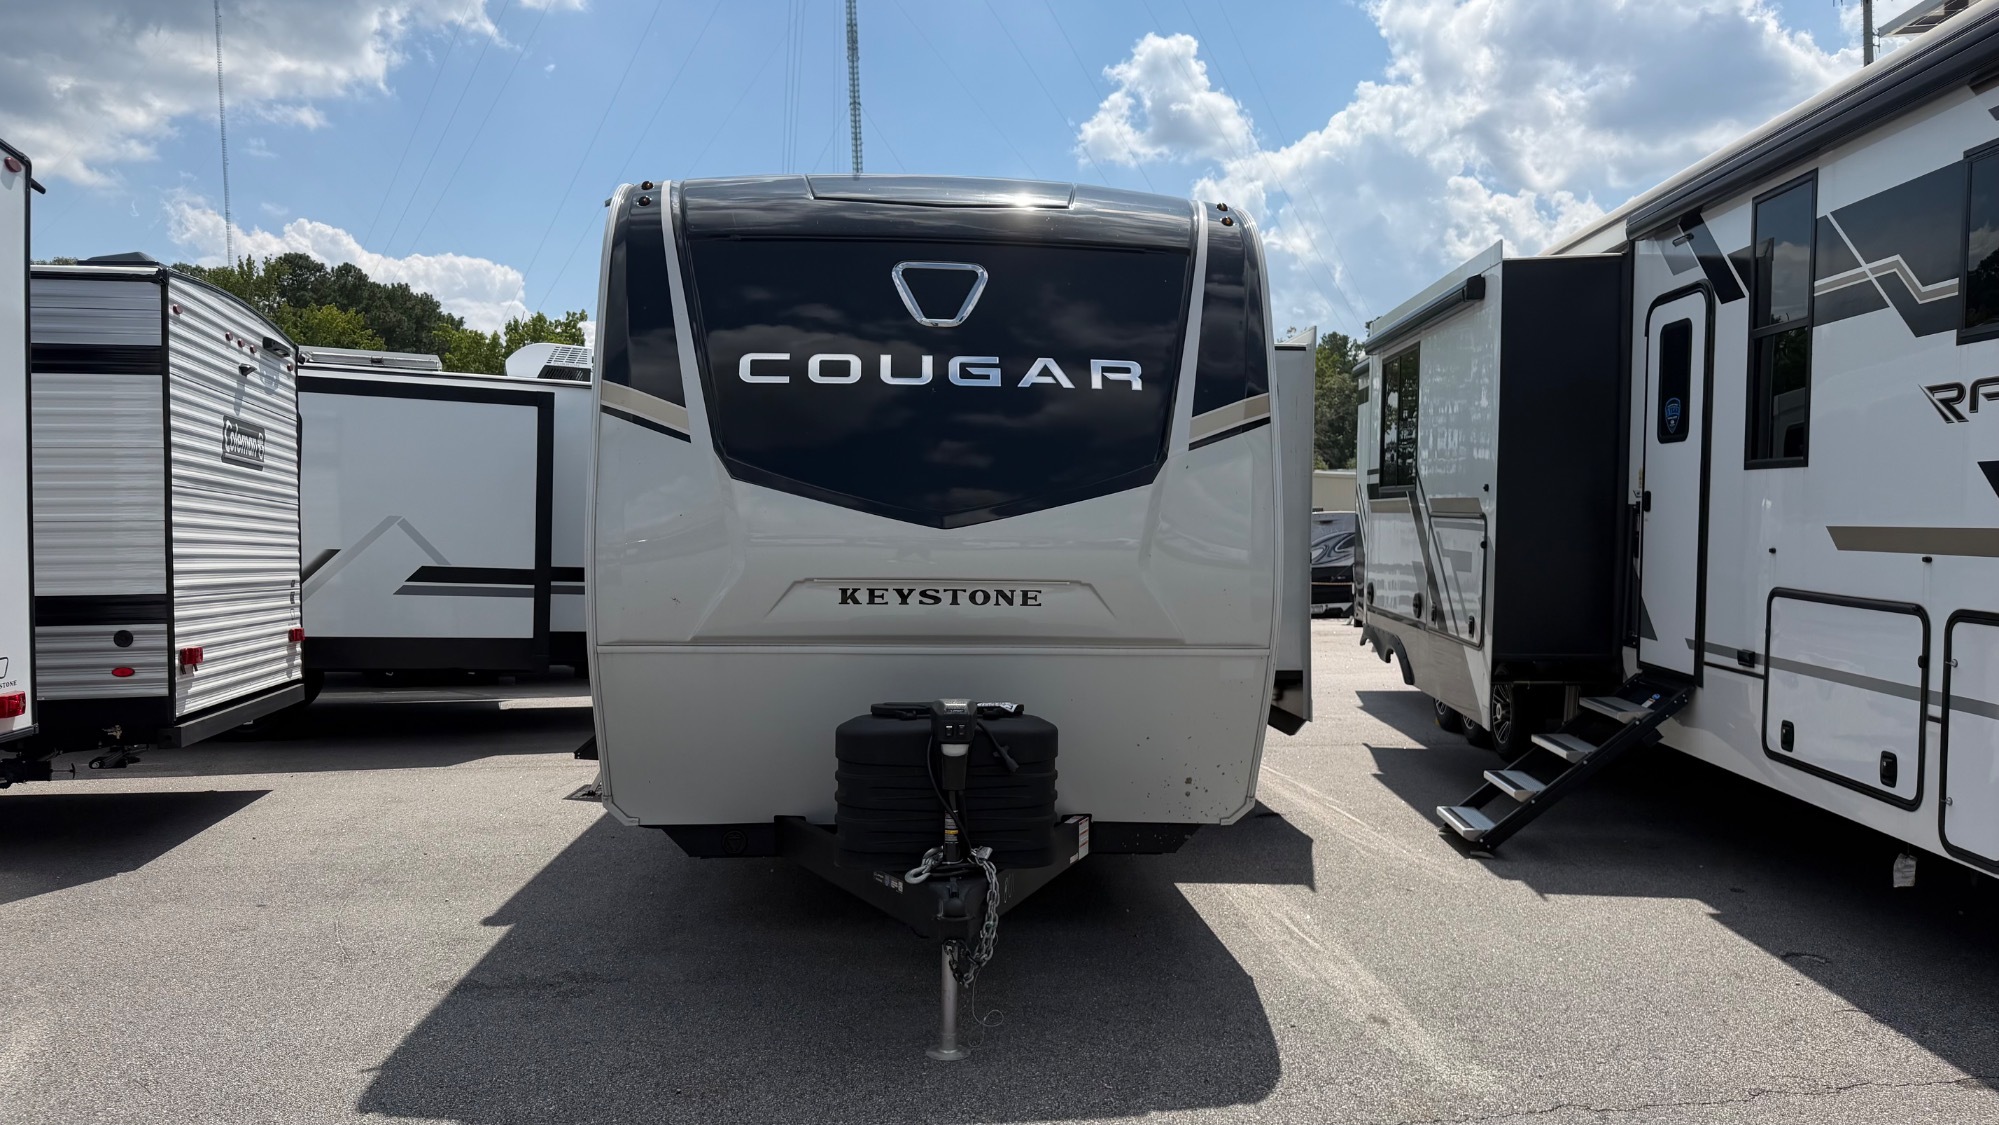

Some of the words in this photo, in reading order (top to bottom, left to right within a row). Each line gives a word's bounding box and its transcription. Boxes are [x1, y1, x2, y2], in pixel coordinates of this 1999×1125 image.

[738, 353, 1143, 391] COUGAR
[225, 420, 258, 457] Coleman
[839, 587, 1044, 607] KEYSTONE
